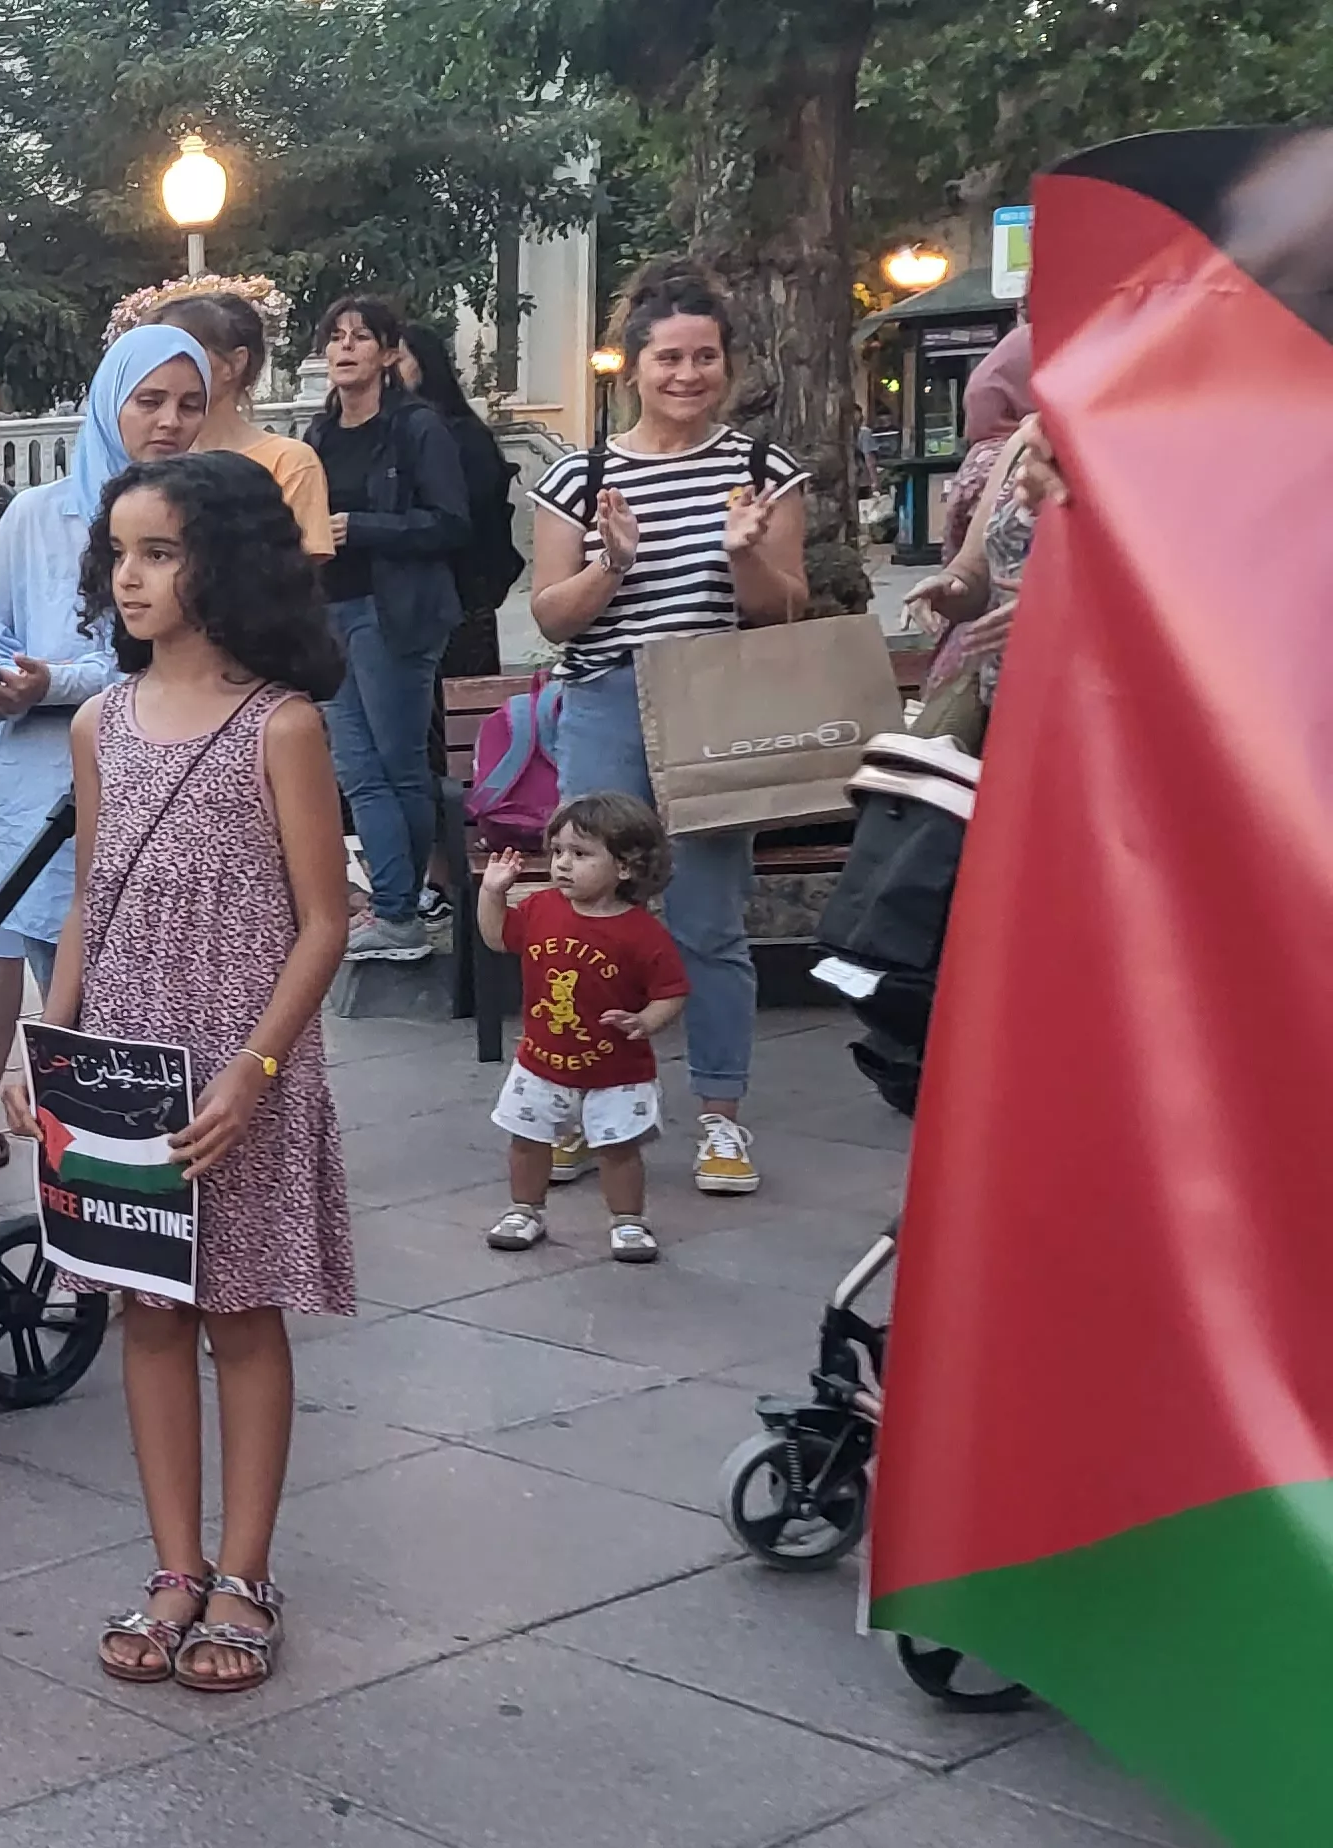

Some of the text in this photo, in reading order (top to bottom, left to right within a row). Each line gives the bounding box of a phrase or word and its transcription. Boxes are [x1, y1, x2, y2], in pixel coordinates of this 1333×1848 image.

[528, 937, 620, 979] PETITS
[70, 1047, 184, 1093] فلسطين
[40, 1181, 194, 1242] FREE PALESTINE
